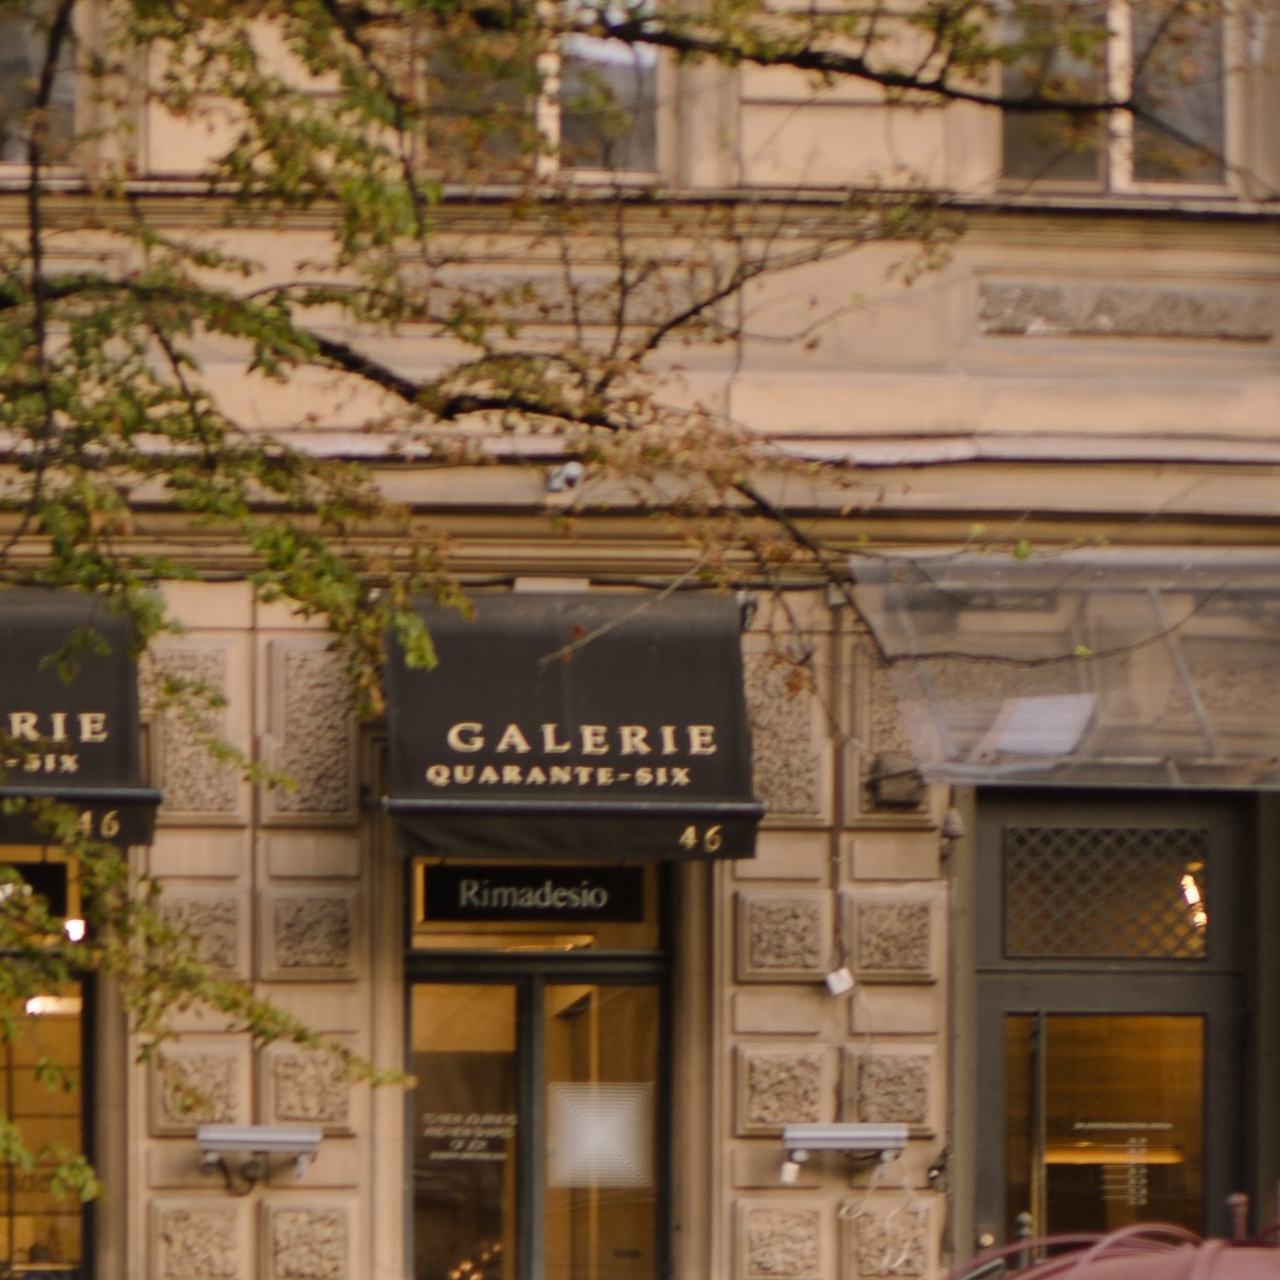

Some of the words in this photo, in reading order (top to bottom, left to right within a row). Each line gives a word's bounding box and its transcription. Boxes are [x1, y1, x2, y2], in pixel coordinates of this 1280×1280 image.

[446, 722, 717, 755] GALERIE
[425, 764, 691, 787] QUARANTE-SIX
[74, 810, 120, 837] 46
[678, 825, 723, 852] 46
[458, 879, 609, 907] Rimadesio
